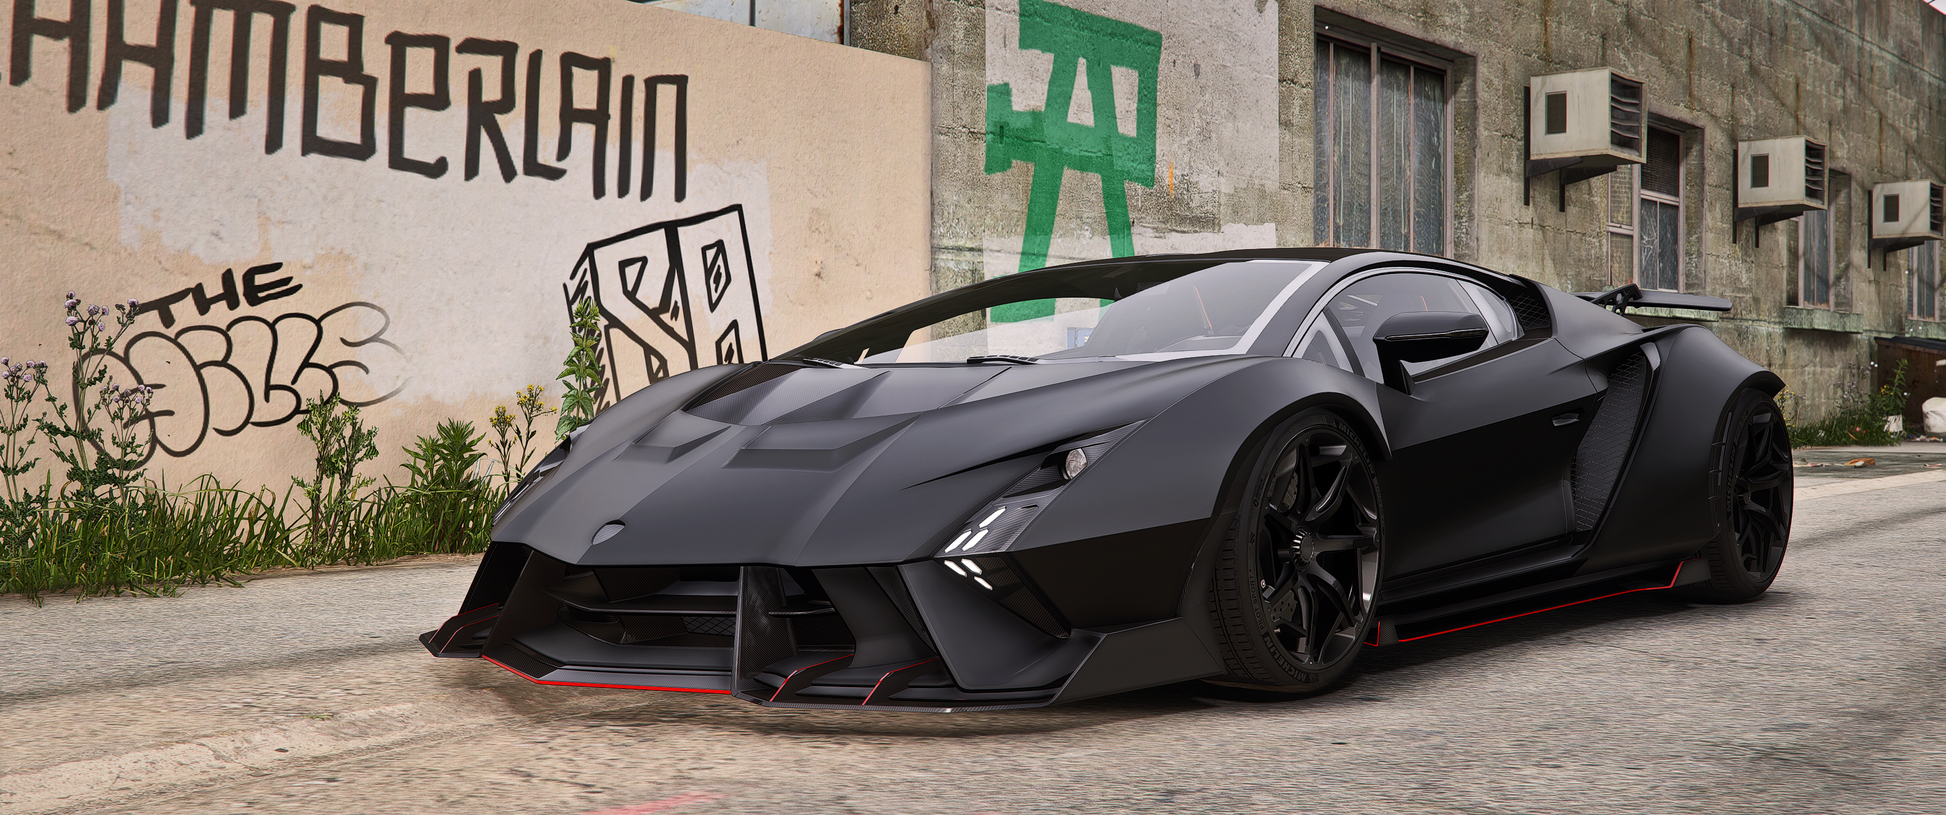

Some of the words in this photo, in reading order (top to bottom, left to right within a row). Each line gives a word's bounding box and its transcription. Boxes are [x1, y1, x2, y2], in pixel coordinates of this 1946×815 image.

[134, 262, 303, 329] THE
[1254, 607, 1265, 630] PILOT
[1263, 635, 1307, 682] MICHELIN
